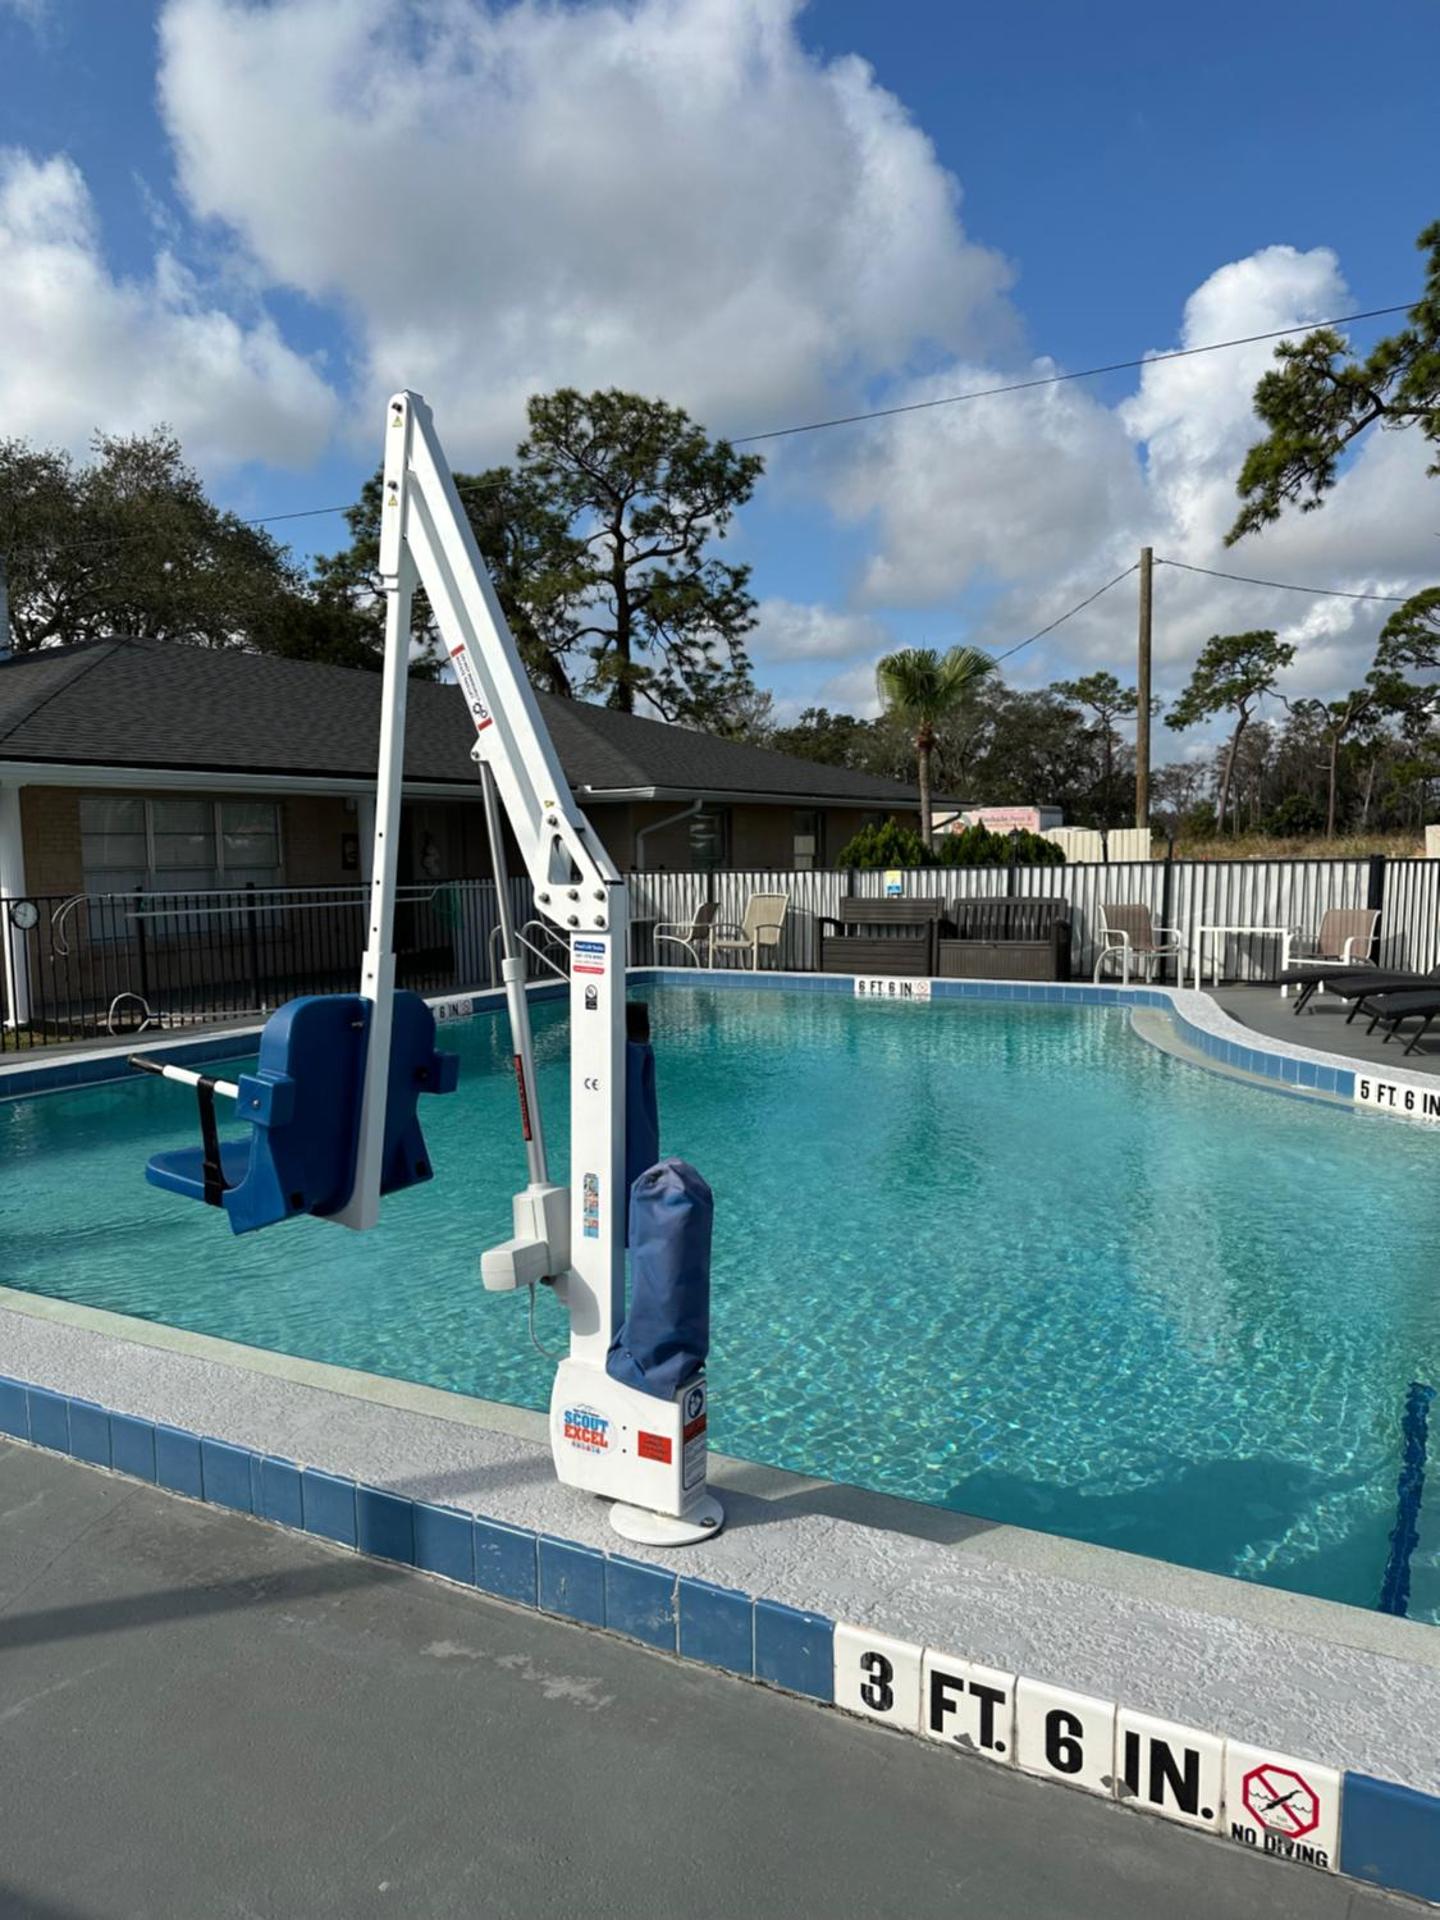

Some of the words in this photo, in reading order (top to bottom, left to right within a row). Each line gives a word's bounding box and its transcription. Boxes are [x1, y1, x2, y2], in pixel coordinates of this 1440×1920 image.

[859, 981, 866, 992] 6
[888, 981, 896, 993] 6
[440, 1005, 446, 1018] 6
[1361, 1080, 1370, 1099] 5
[1405, 1090, 1415, 1110] 6
[564, 1410, 608, 1433] SCOUT
[564, 1424, 608, 1448] EXCEL
[860, 1651, 894, 1712] 3
[930, 1669, 1006, 1753] FT.
[1045, 1709, 1083, 1774] 6
[1125, 1730, 1214, 1820] IN.
[1231, 1822, 1257, 1846] NO
